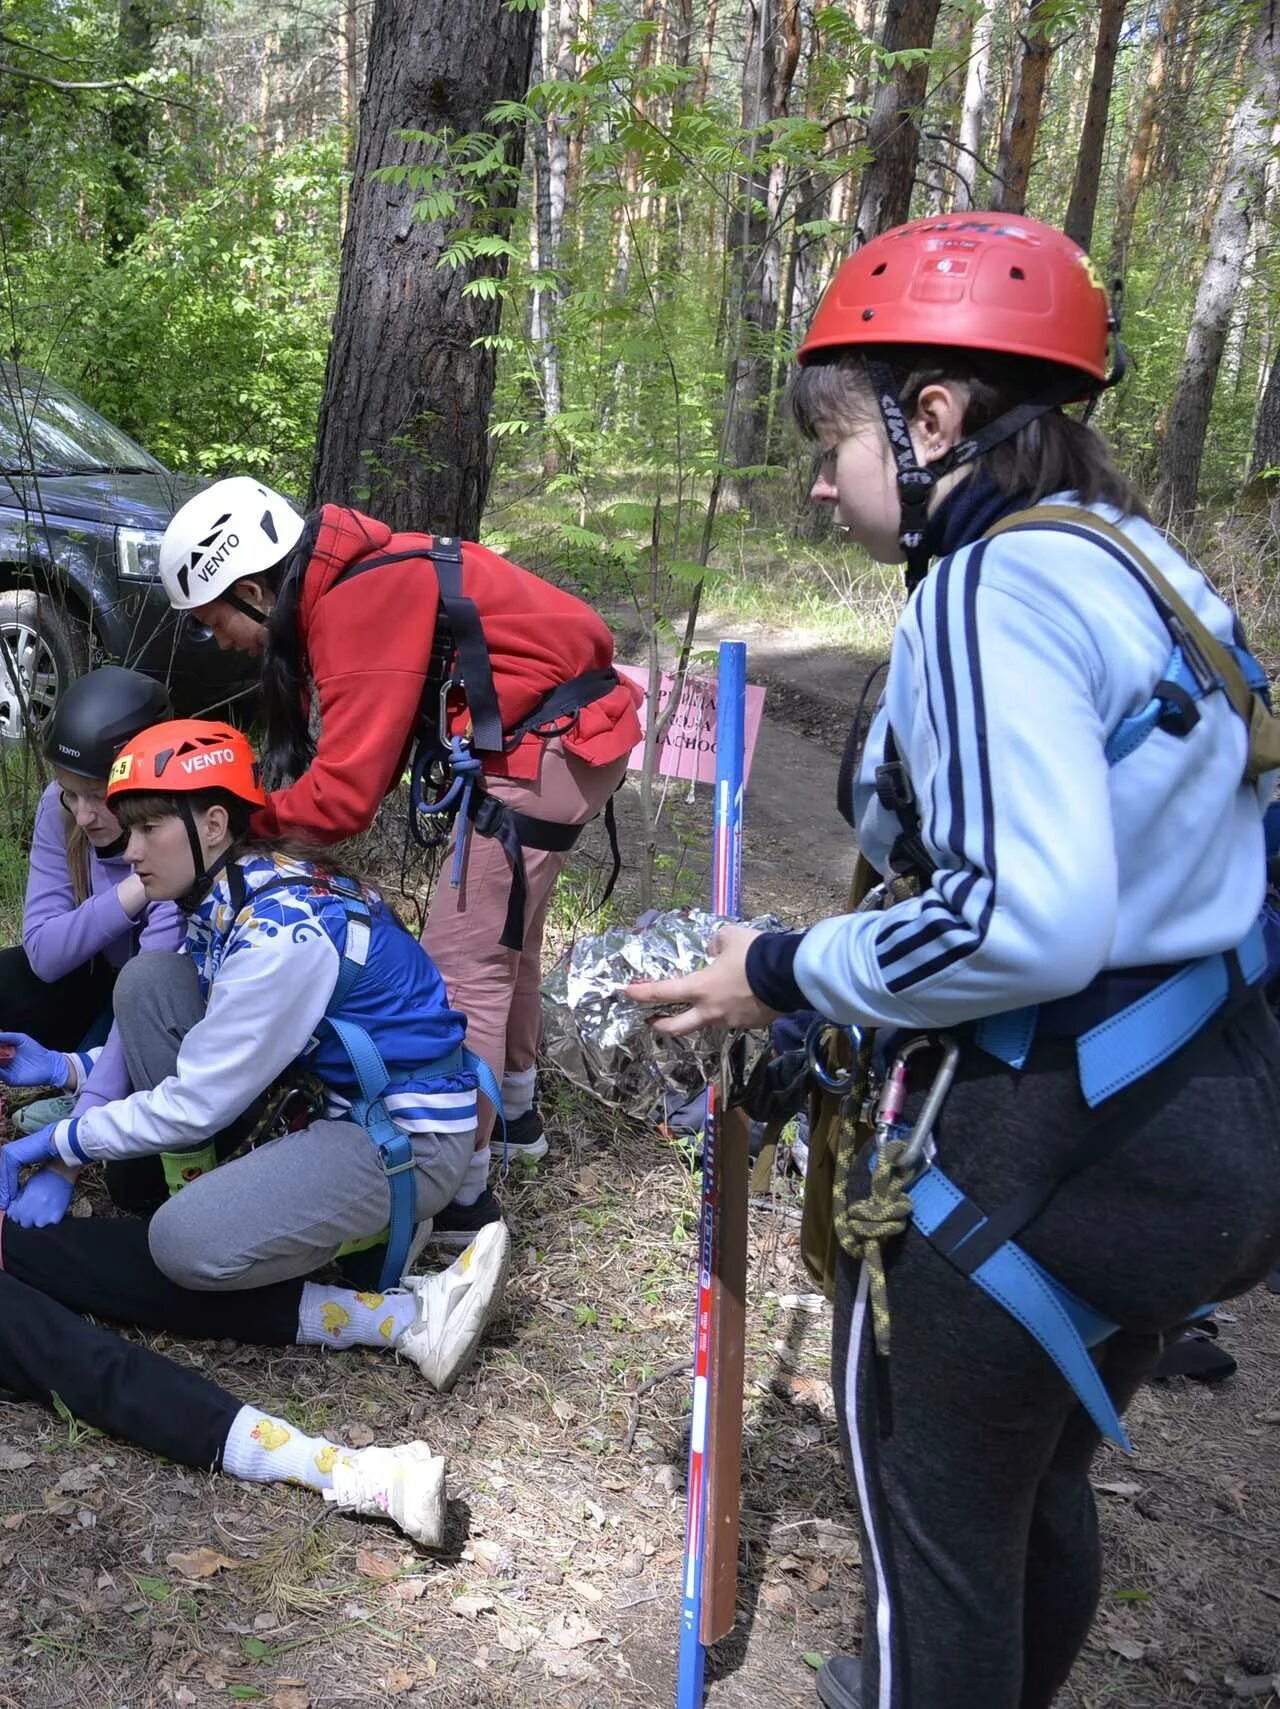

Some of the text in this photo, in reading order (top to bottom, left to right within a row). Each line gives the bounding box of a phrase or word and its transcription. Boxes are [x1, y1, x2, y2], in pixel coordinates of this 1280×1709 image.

[197, 534, 240, 583] VENTO
[58, 744, 81, 758] VENTO
[180, 748, 235, 775] VENTO
